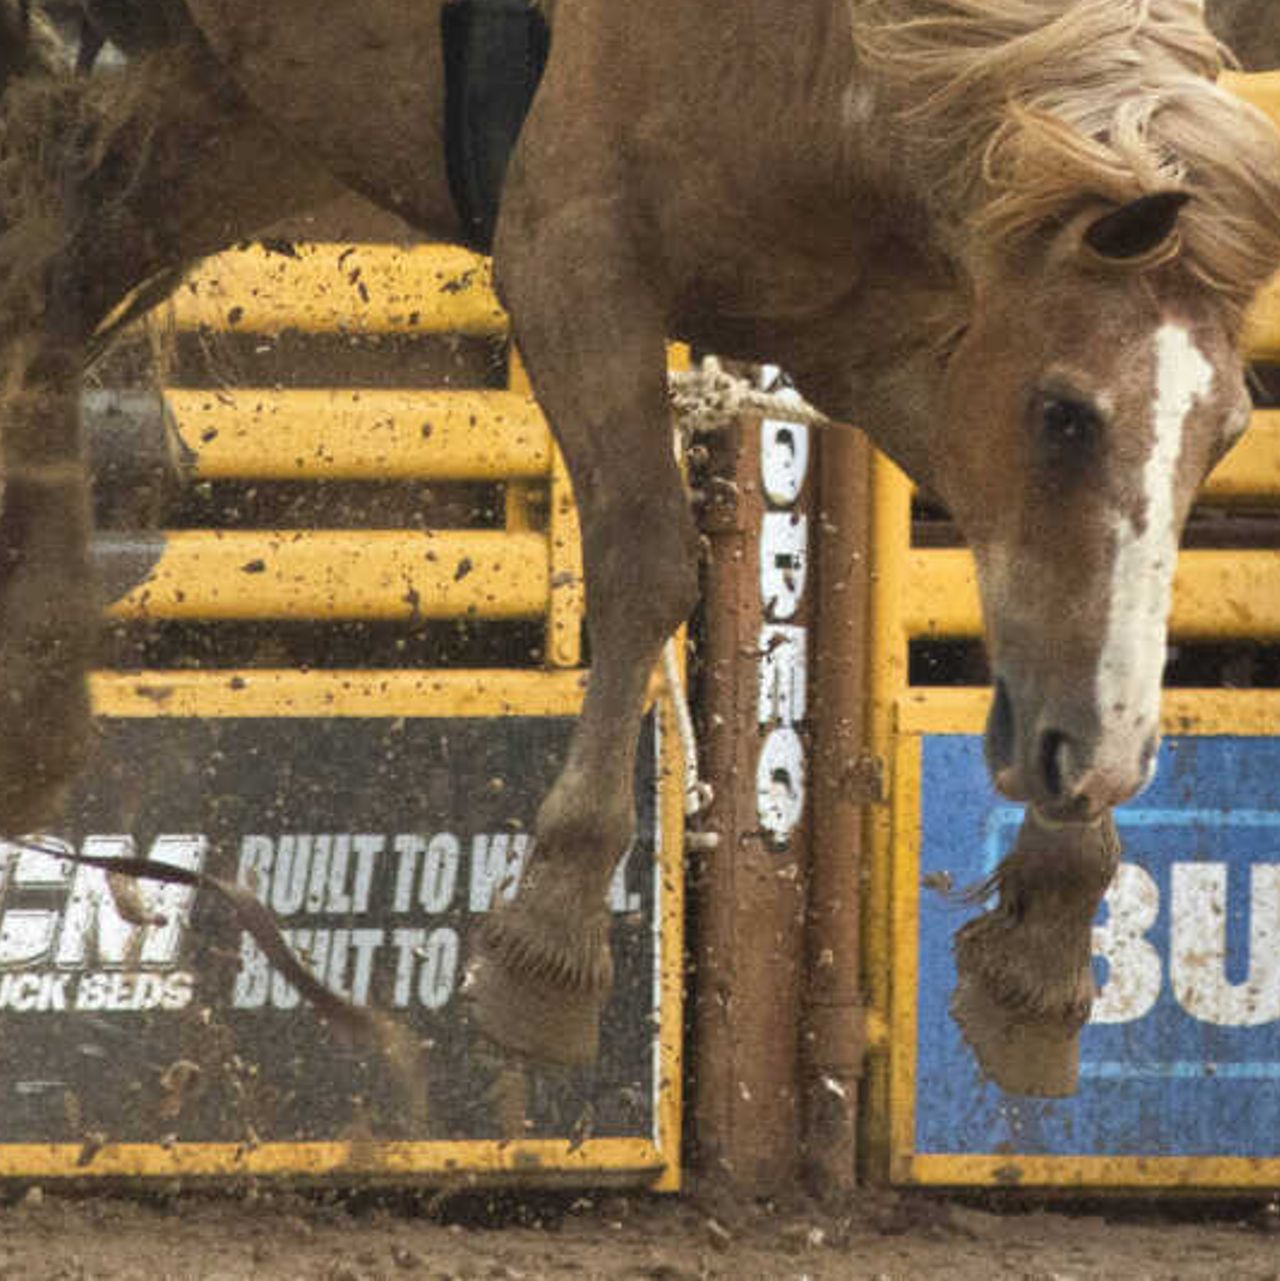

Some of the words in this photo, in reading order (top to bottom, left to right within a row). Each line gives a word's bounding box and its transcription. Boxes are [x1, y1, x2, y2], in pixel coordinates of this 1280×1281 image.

[236, 833, 387, 915] BUILT
[394, 832, 460, 915] TO
[74, 972, 195, 1012] BEDS
[394, 928, 460, 1009] TO
